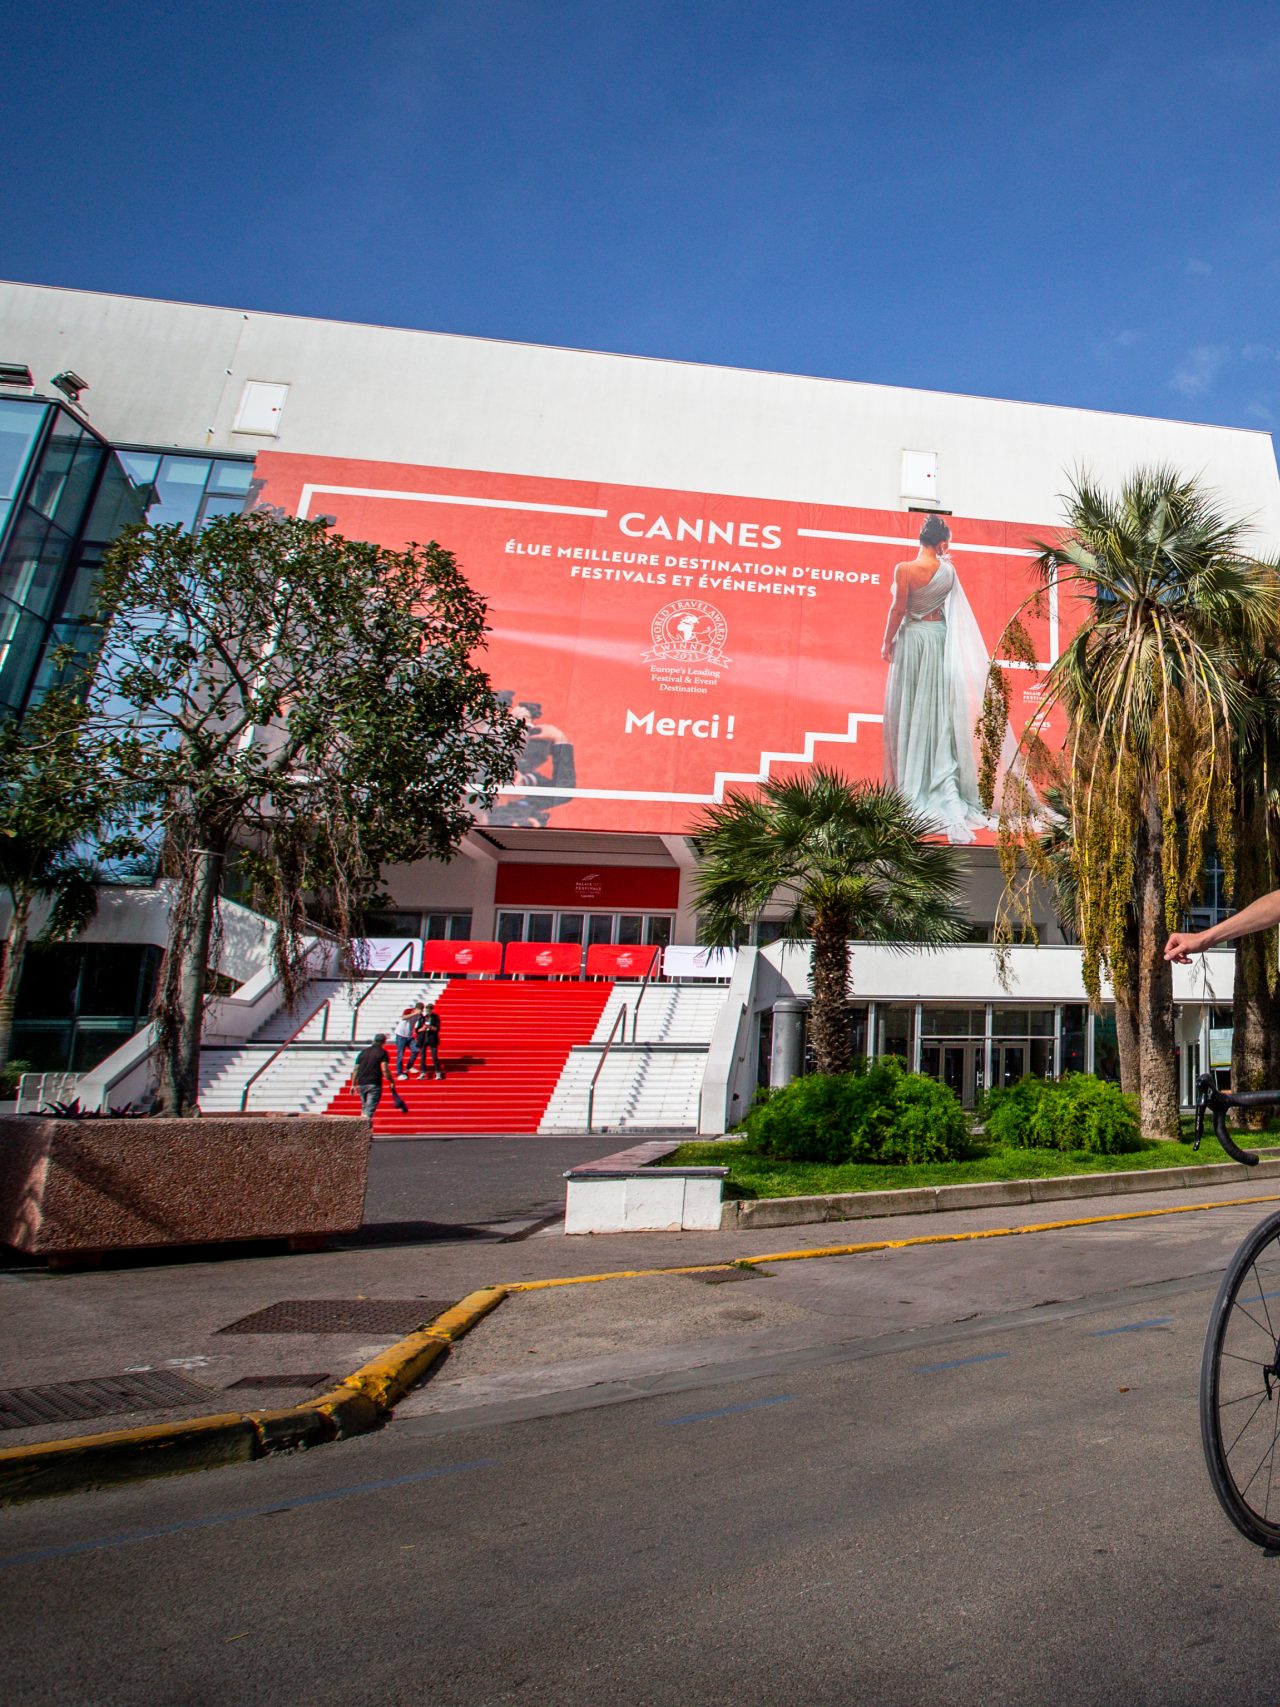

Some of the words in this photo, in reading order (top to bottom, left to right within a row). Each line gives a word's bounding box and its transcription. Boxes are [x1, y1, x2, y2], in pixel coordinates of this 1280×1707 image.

[619, 513, 781, 549] CANNES
[505, 539, 552, 556] ÉLUE
[557, 547, 659, 566] MEILLEURE
[665, 556, 787, 577] DESTINATION
[571, 566, 667, 585] FESTIVALS
[672, 574, 693, 587] ET
[699, 574, 817, 597] ÉVÉNEMENTS
[653, 610, 669, 642] WORLD
[670, 601, 708, 612] TRAVEL
[709, 611, 726, 646] AWARDS
[661, 643, 714, 656] WINNER
[673, 651, 700, 660] 2021
[688, 667, 720, 679] Leading
[651, 674, 682, 683] Festival
[684, 675, 692, 683] &
[694, 676, 717, 686] Event
[659, 683, 708, 693] Destination
